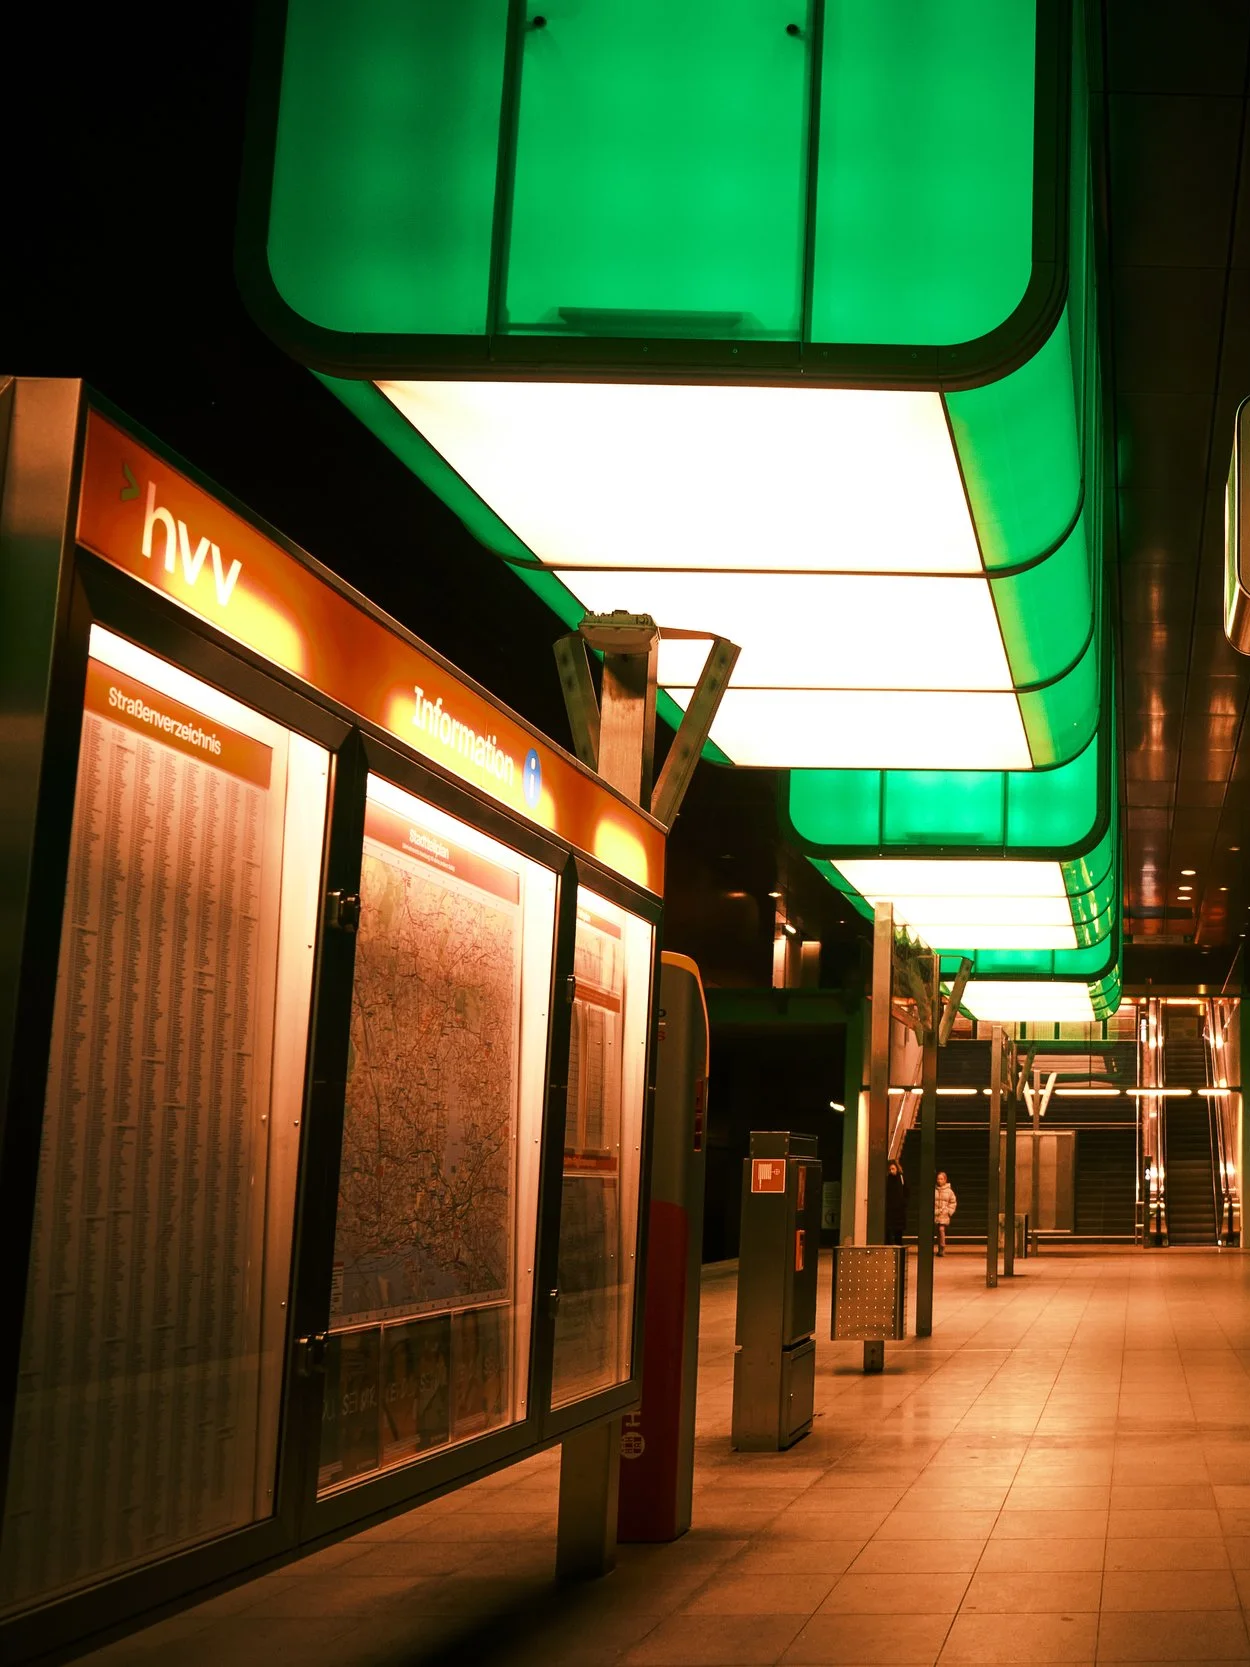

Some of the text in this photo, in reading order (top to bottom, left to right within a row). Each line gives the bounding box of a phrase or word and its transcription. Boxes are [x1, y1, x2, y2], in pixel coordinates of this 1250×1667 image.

[141, 480, 243, 607] hvv
[108, 686, 222, 756] Straßenverzeichnis
[411, 685, 515, 787] Information
